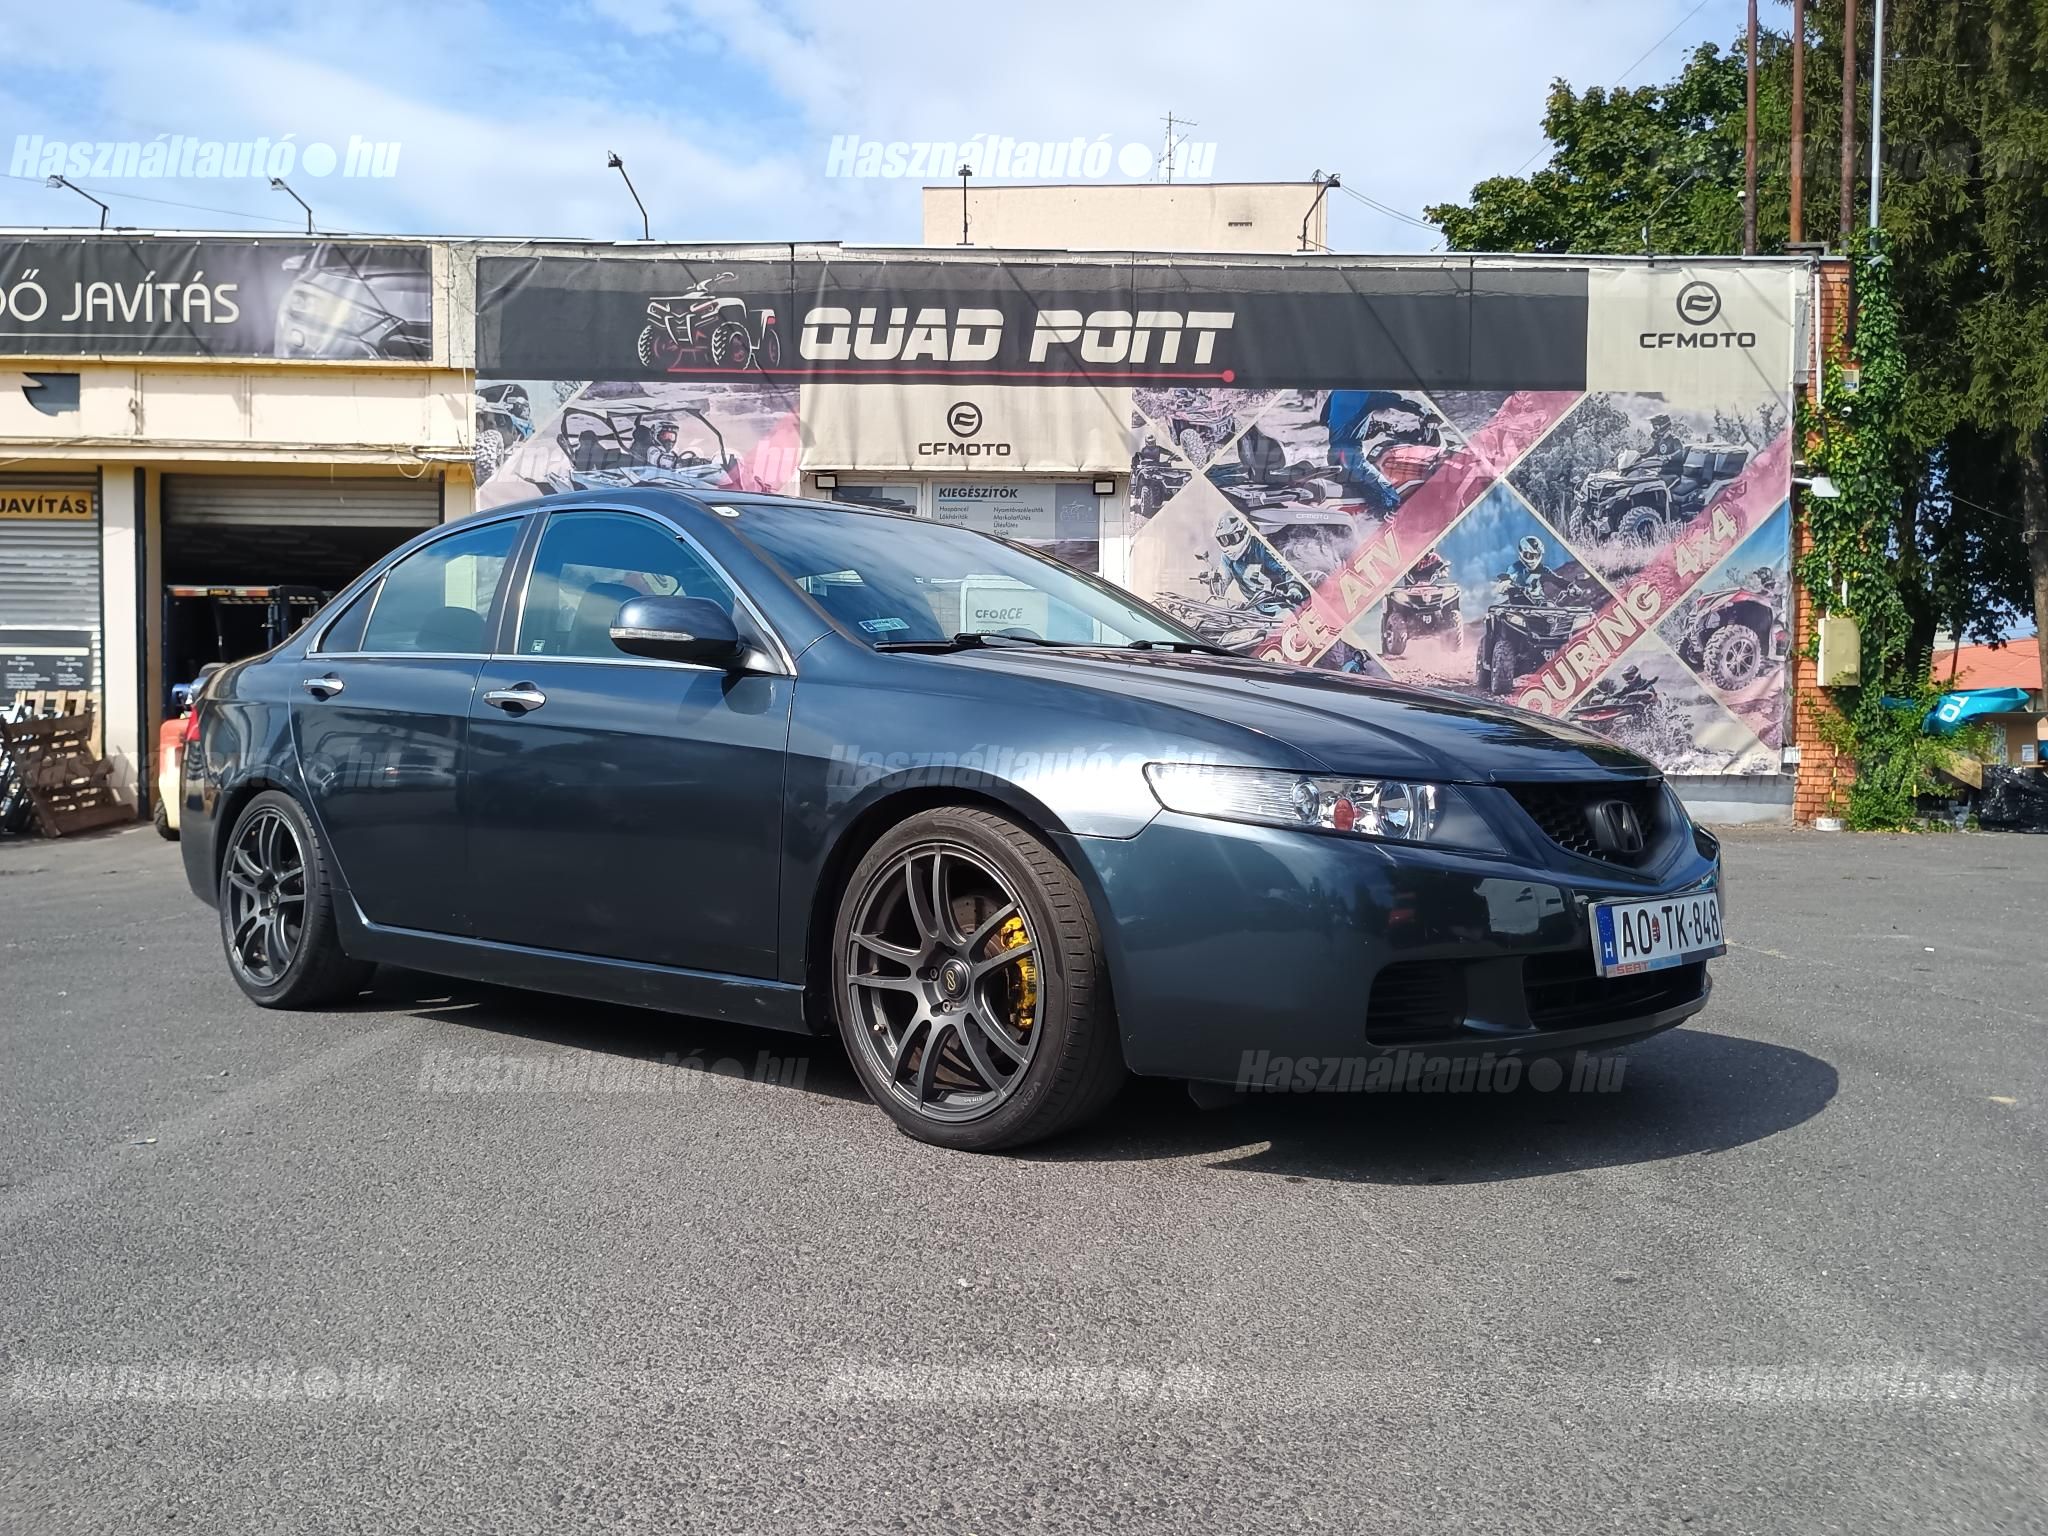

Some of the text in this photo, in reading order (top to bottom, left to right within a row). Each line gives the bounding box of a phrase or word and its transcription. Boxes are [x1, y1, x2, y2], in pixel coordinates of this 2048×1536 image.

[0, 268, 240, 324] Ő JAVÍTÁS
[800, 307, 1235, 364] QUAD PONT
[1639, 332, 1756, 349] CFMOTO
[918, 442, 1011, 456] CFMOTO
[937, 485, 1018, 498] KIEGÉSZÍTŐK
[1339, 524, 1402, 614] ATV
[1604, 941, 1614, 959] H
[1621, 909, 1653, 958] AO
